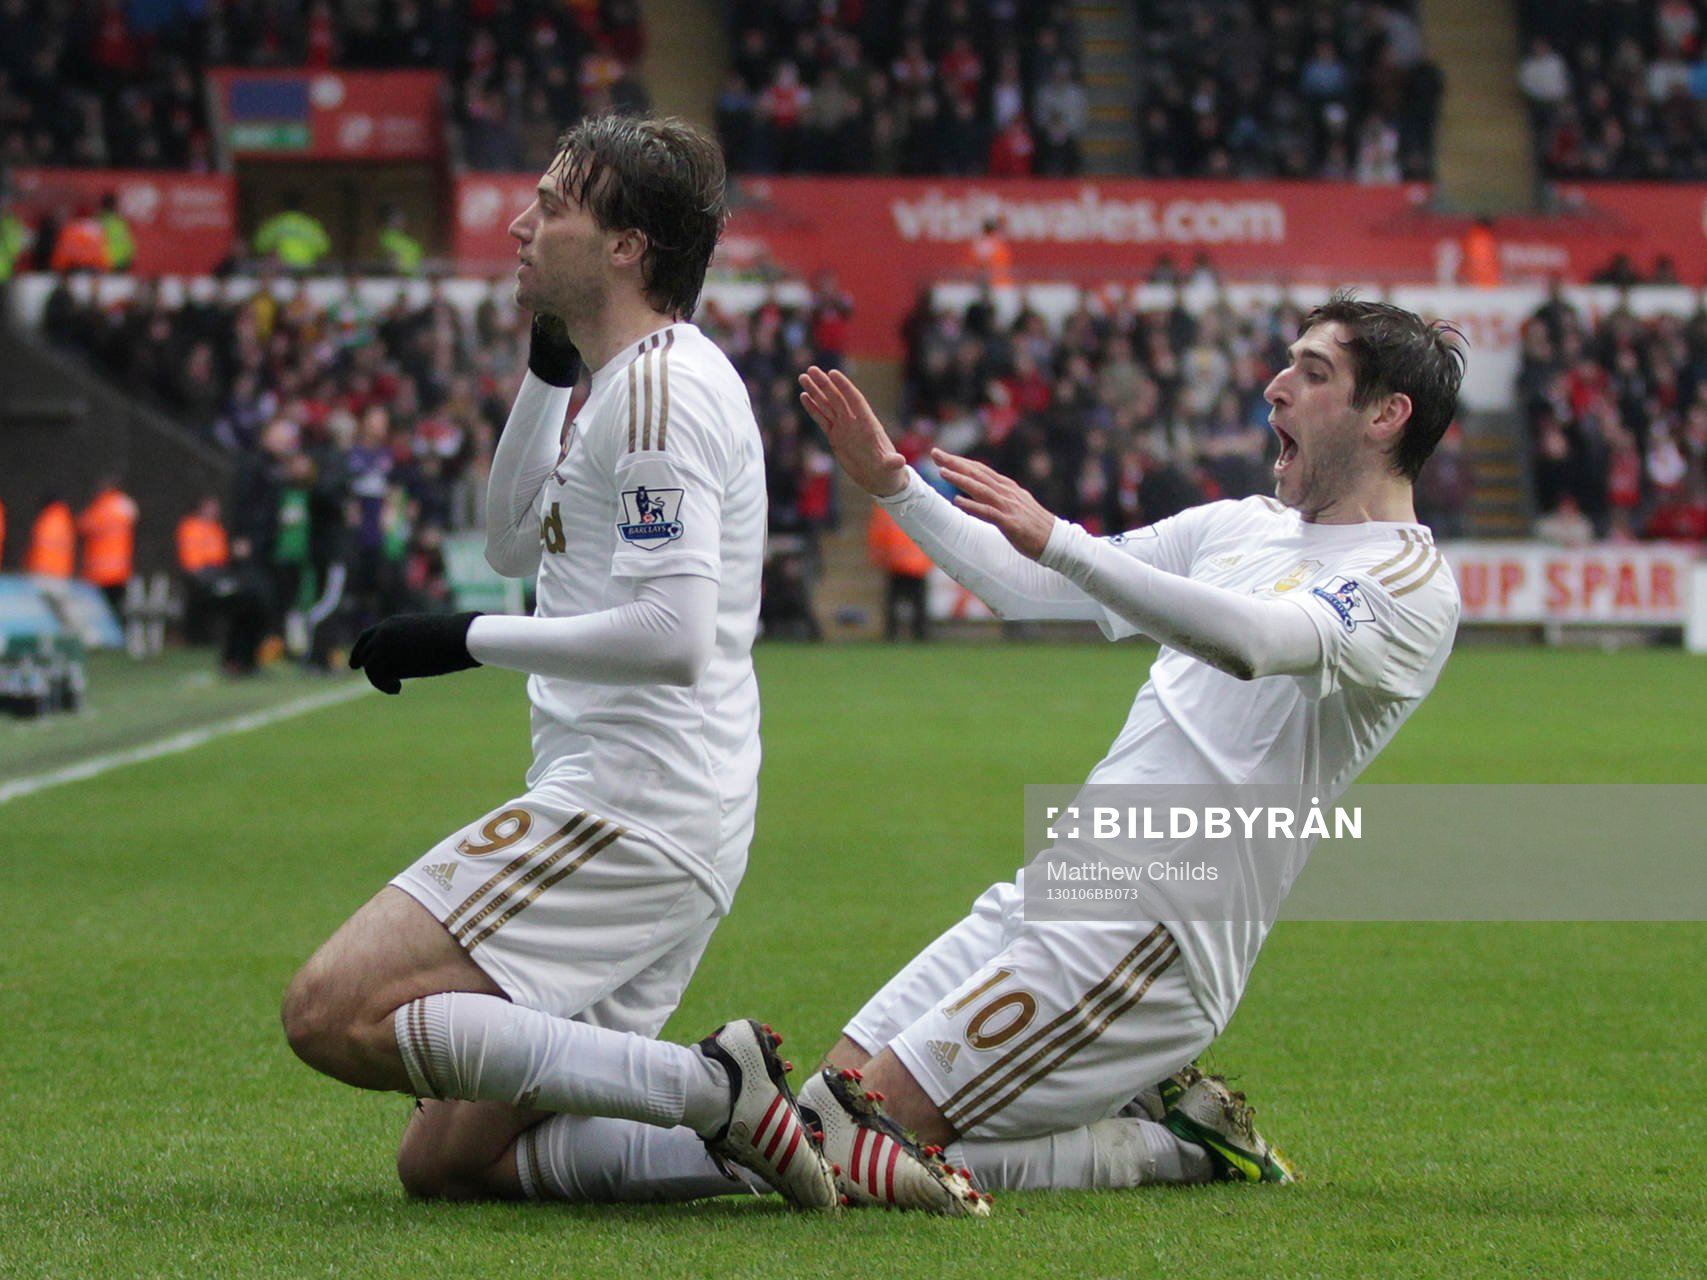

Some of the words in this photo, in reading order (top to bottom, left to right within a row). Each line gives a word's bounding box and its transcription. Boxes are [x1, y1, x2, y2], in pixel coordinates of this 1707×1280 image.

[628, 525, 667, 535] BARCLAYS
[1544, 561, 1677, 613] SPAR
[455, 808, 535, 858] 9
[943, 967, 1039, 1052] 10
